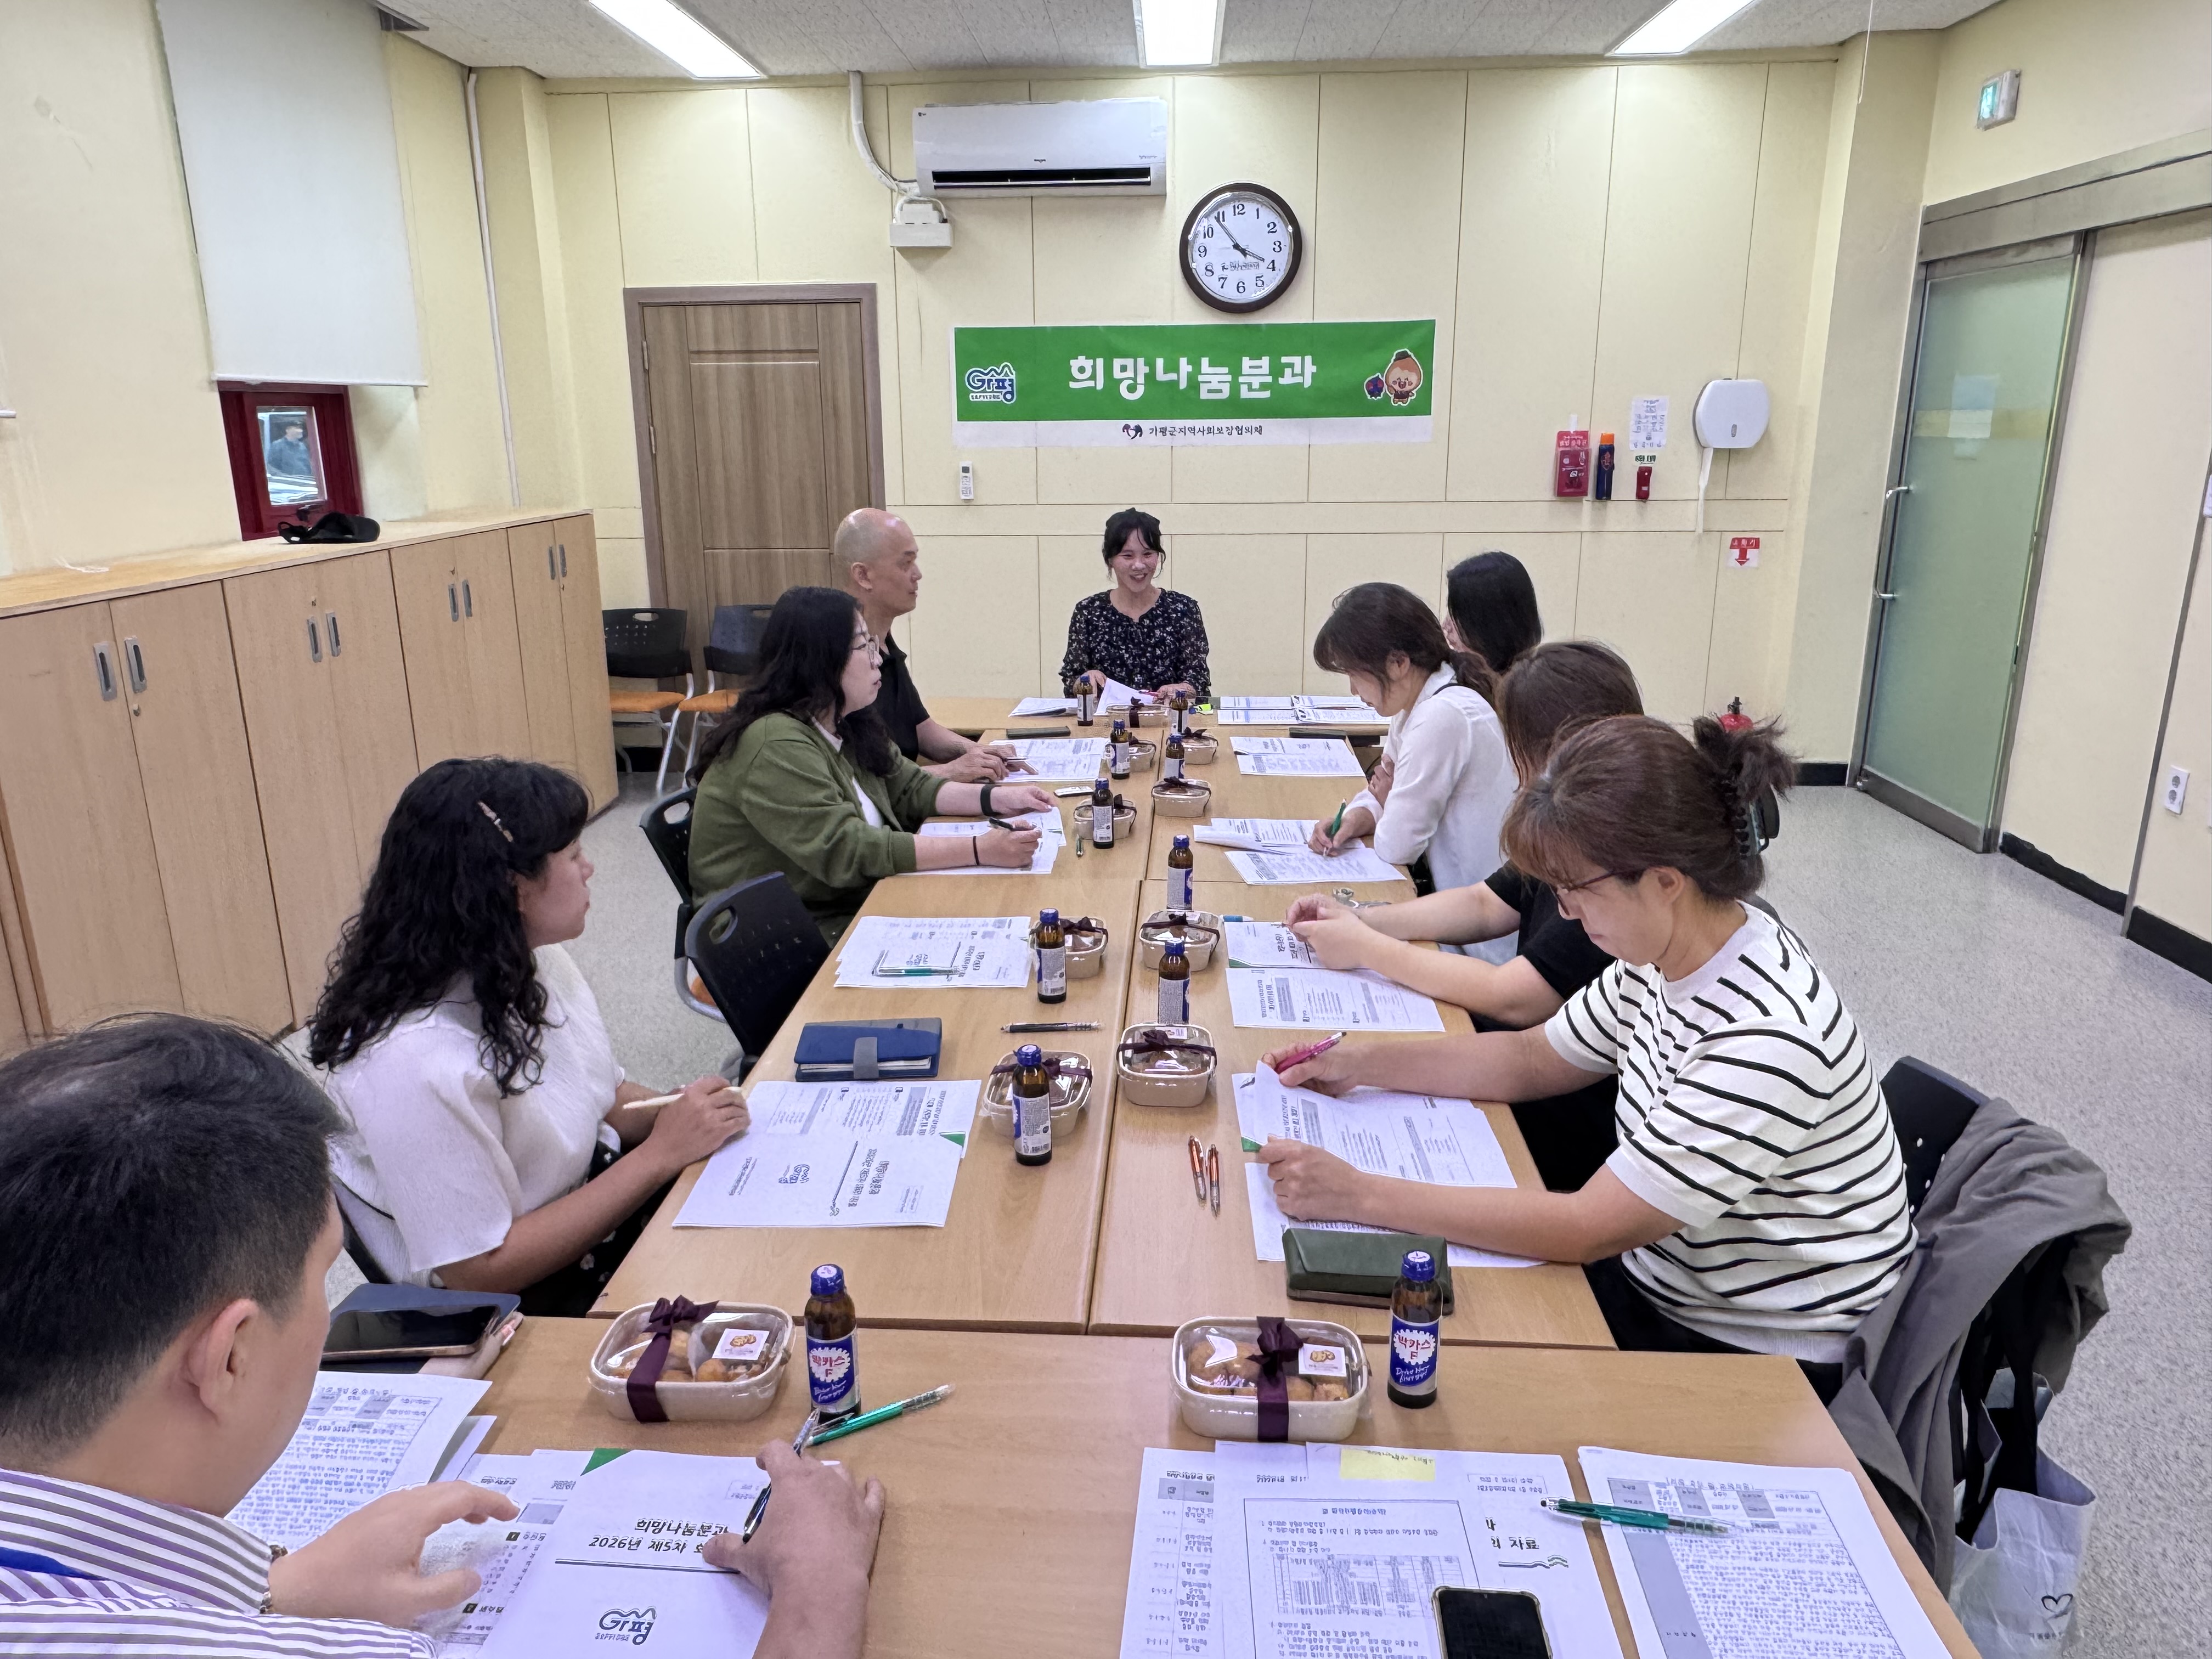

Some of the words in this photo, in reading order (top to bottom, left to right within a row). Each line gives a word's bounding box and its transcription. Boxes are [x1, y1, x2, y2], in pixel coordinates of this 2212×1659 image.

[1216, 210, 1226, 222] 11
[1232, 204, 1246, 216] 12
[1256, 207, 1260, 219] 1
[1203, 224, 1214, 239] 10
[1267, 222, 1278, 234] 2
[1198, 245, 1207, 258] 9
[1272, 240, 1283, 253] 3
[1204, 264, 1215, 277] 8
[1266, 259, 1277, 272] 4
[1217, 276, 1228, 289] 7
[1236, 281, 1246, 294] 6
[1255, 275, 1265, 287] 5
[1069, 355, 1317, 400] 희망나눔분과
[588, 1536, 642, 1551] 2026년
[648, 1538, 687, 1554] 제5차
[1509, 1537, 1540, 1550] 자료
